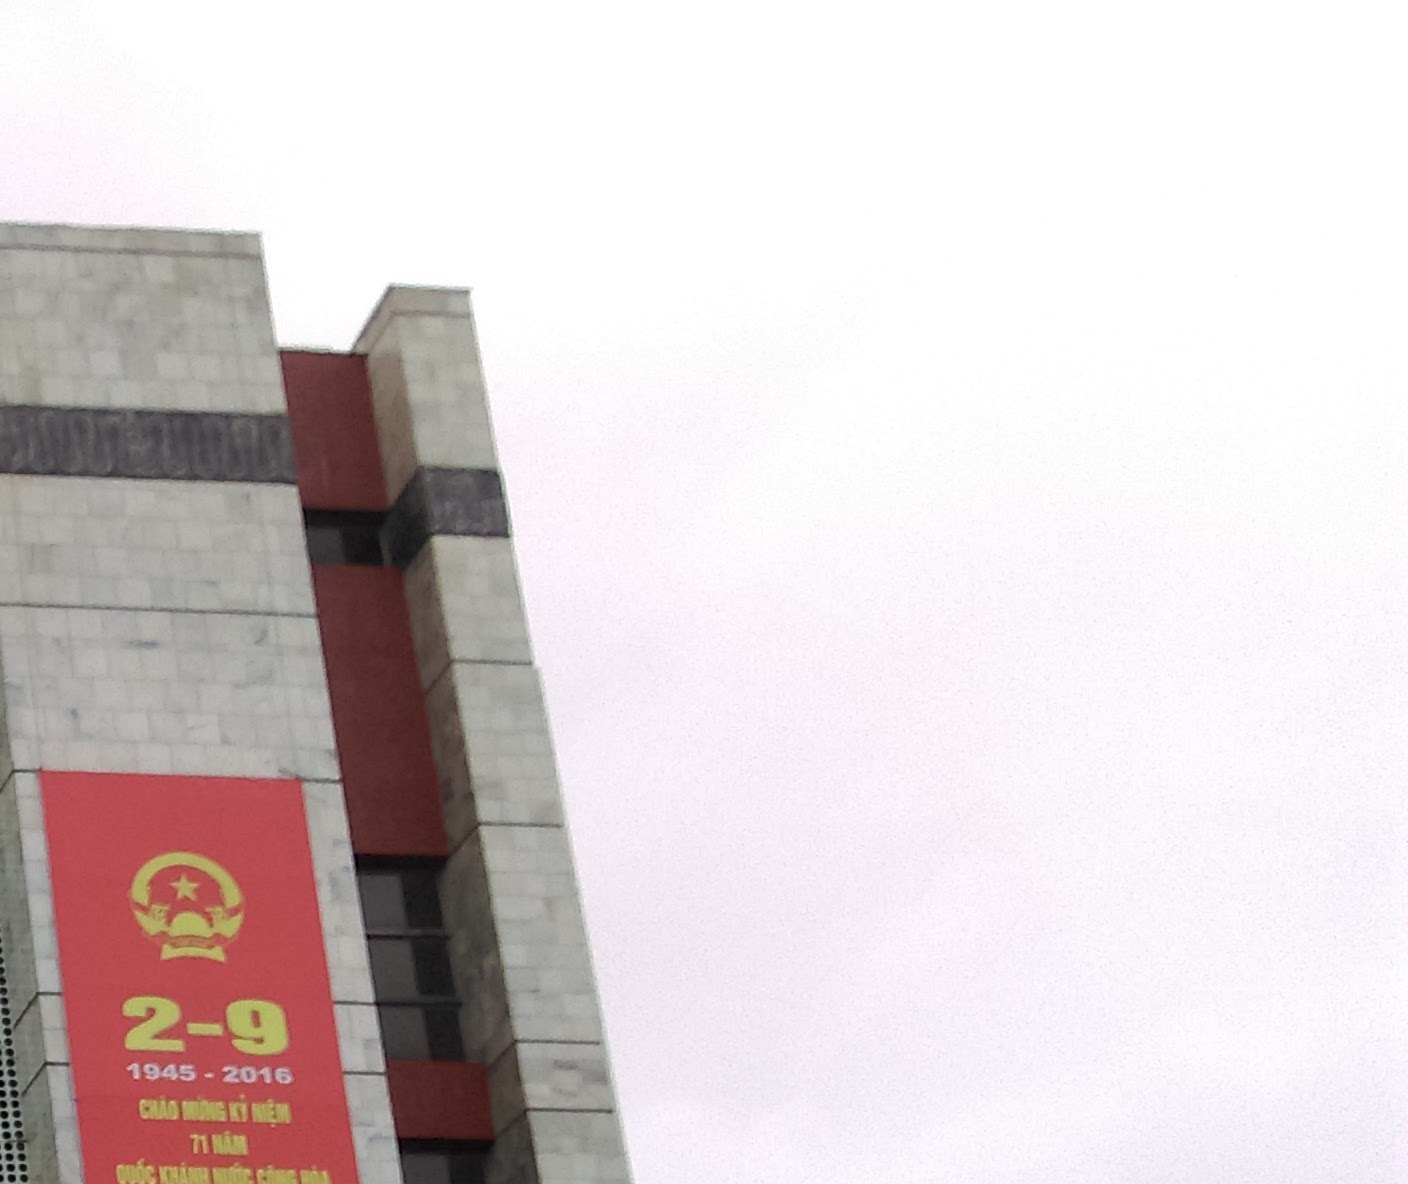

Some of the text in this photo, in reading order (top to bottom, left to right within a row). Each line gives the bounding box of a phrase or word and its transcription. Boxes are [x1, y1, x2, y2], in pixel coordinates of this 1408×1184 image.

[122, 996, 289, 1056] 2-9
[126, 1062, 196, 1082] 1945
[223, 1065, 293, 1085] 2016
